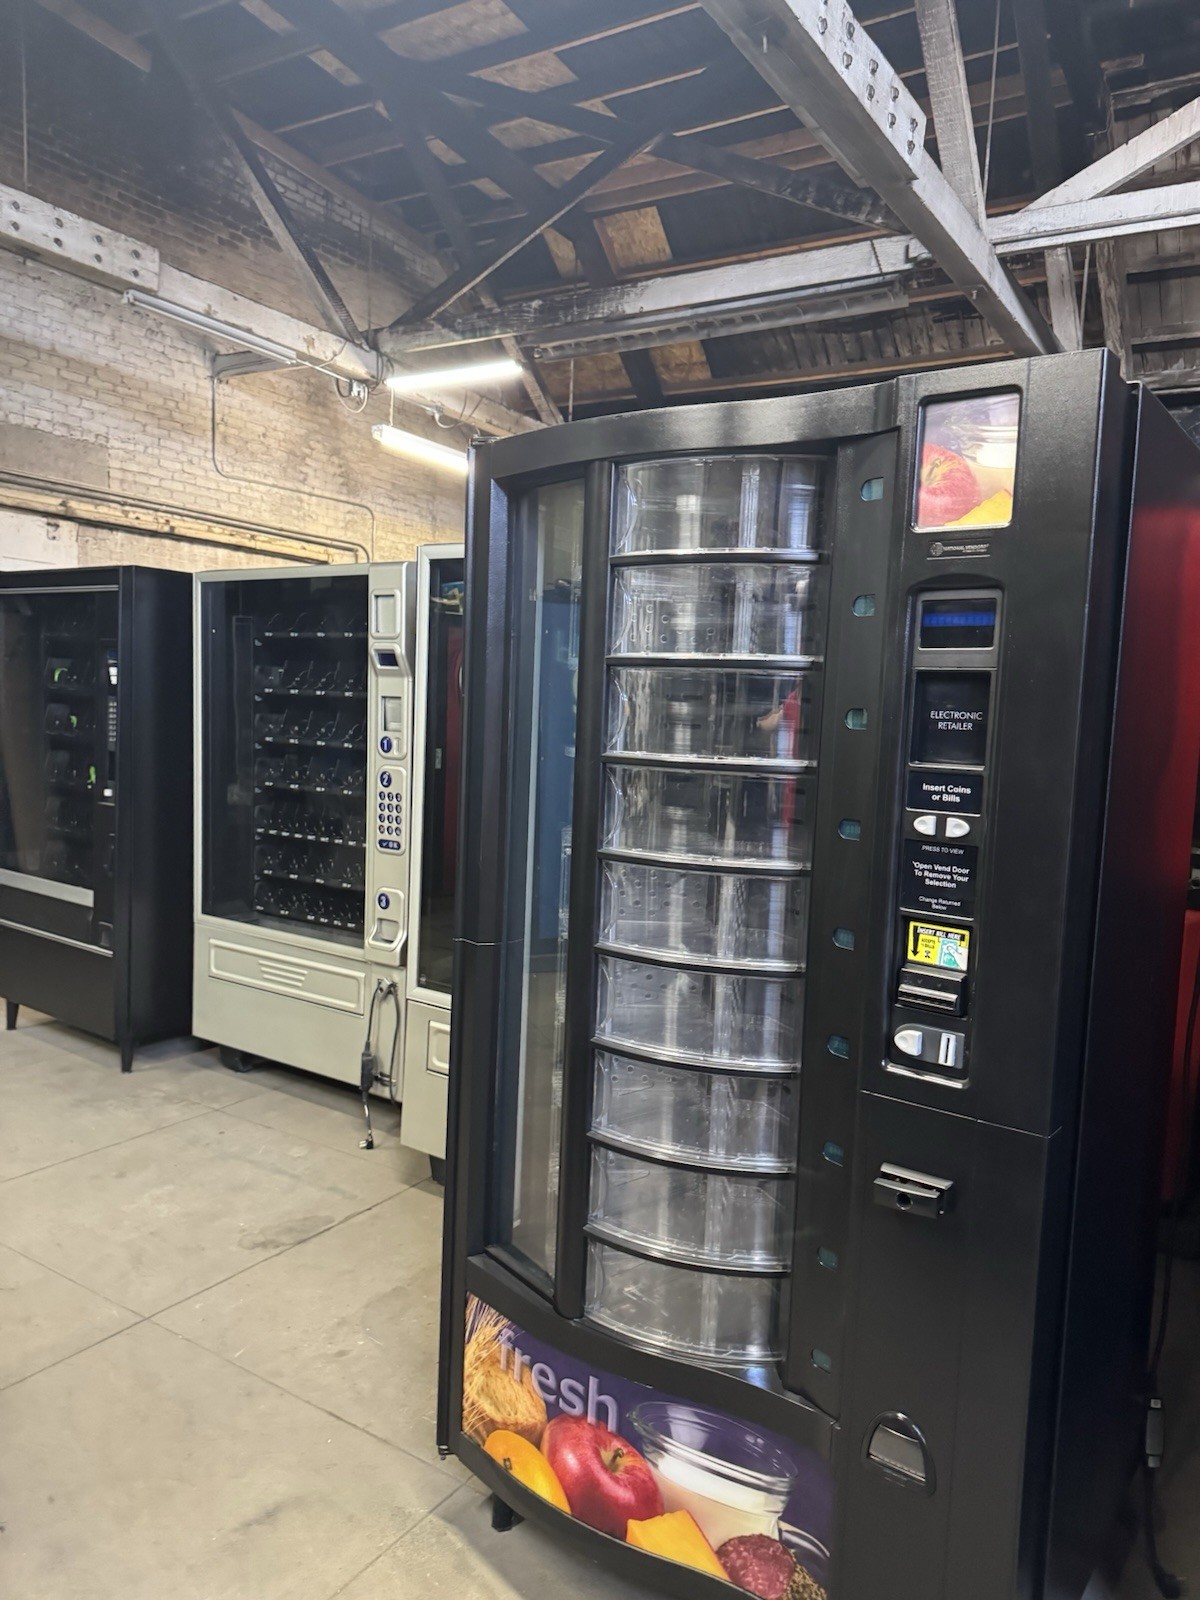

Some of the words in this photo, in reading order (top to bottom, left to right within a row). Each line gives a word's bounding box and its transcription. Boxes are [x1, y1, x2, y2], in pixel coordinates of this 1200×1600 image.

[930, 710, 983, 720] ELECTRONIC
[938, 722, 973, 730] RETAILER
[382, 739, 388, 751] 1
[382, 774, 388, 786] 2
[922, 782, 946, 792] Insert
[947, 784, 972, 794] Coins
[942, 794, 960, 803] Bills
[933, 864, 950, 872] Vend
[952, 866, 970, 874] Door
[924, 870, 952, 880] Remove
[952, 874, 970, 882] Your
[924, 878, 956, 888] Selection
[380, 896, 386, 908] 3
[917, 926, 936, 936] INSERT
[498, 1328, 619, 1433] fresh
